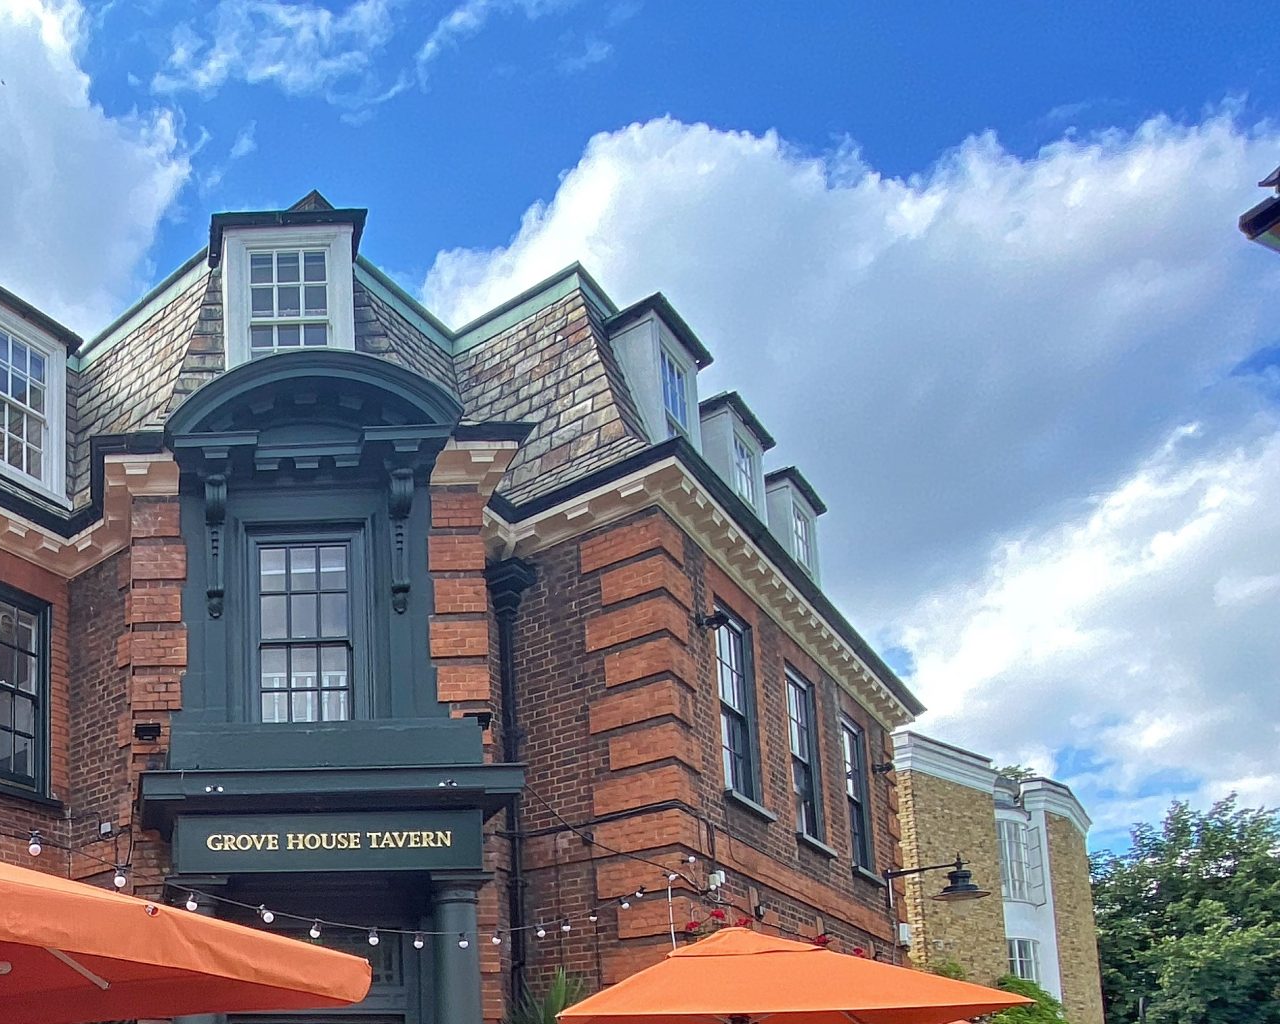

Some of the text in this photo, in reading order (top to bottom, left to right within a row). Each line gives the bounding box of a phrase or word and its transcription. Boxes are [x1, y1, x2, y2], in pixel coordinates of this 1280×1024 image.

[206, 830, 452, 851] GROVE HOUSE TAVERN
